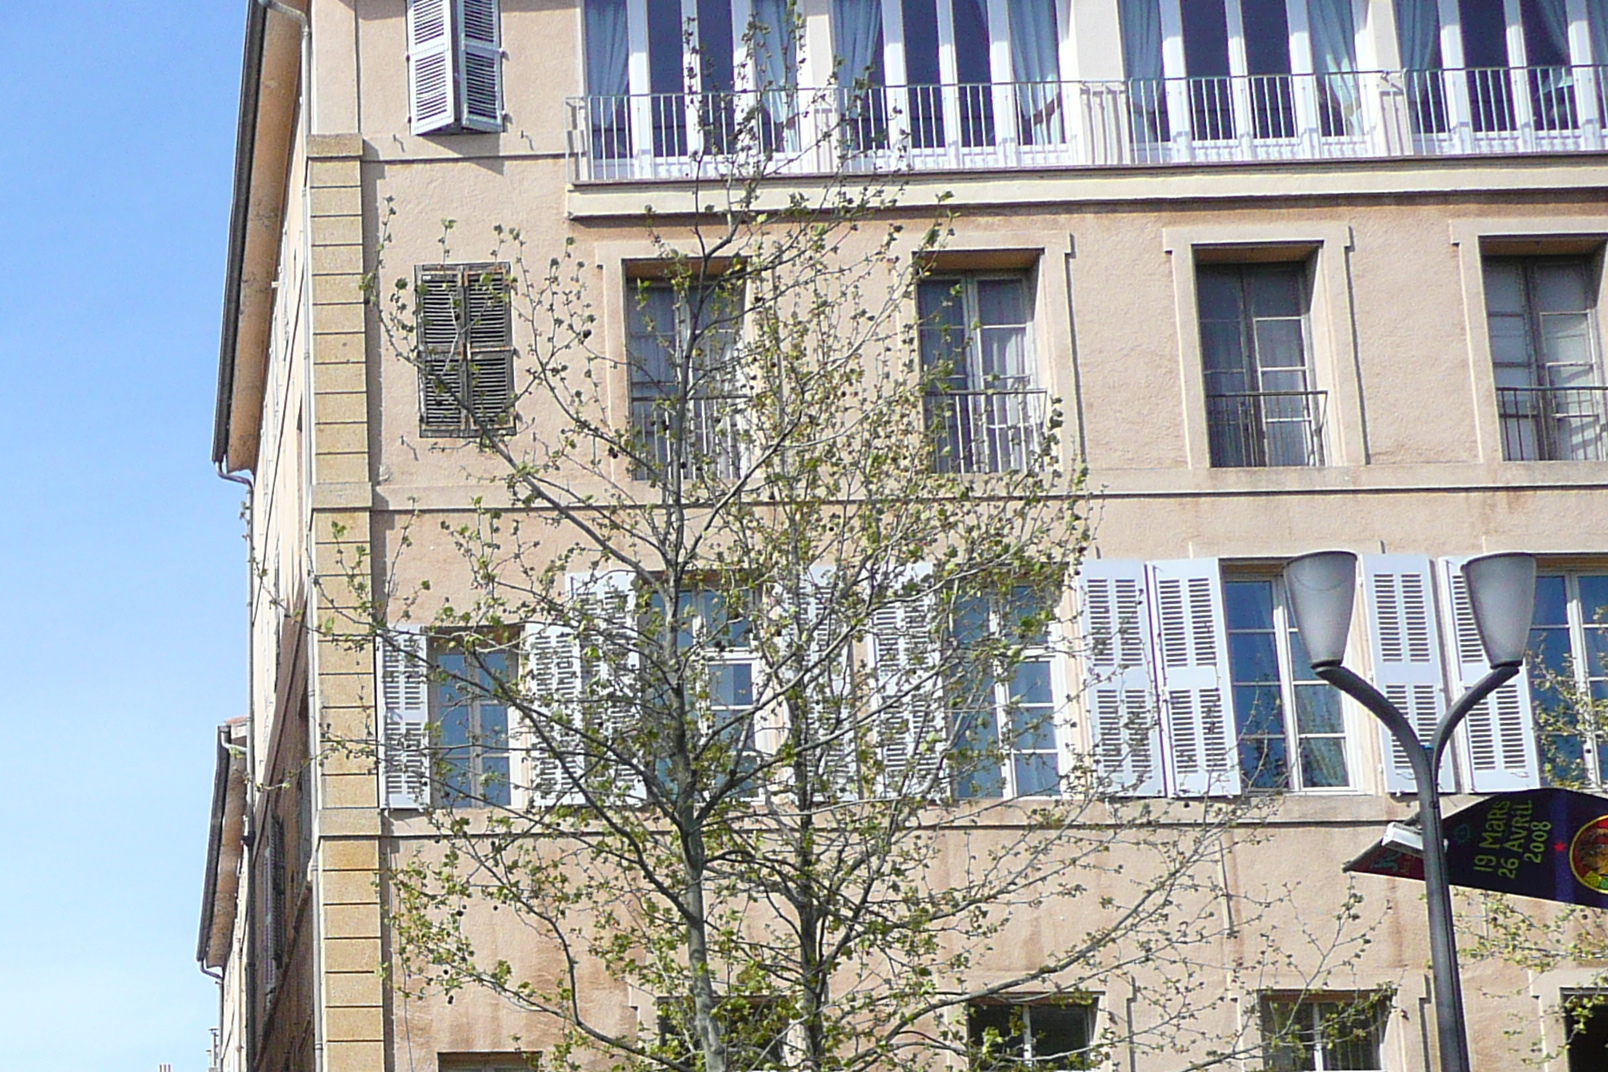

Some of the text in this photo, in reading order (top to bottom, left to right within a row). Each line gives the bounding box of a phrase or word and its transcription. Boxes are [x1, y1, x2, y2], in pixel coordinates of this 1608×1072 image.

[1523, 821, 1552, 863] 2008
[1473, 854, 1497, 871] 19
[1497, 858, 1519, 879] 26
